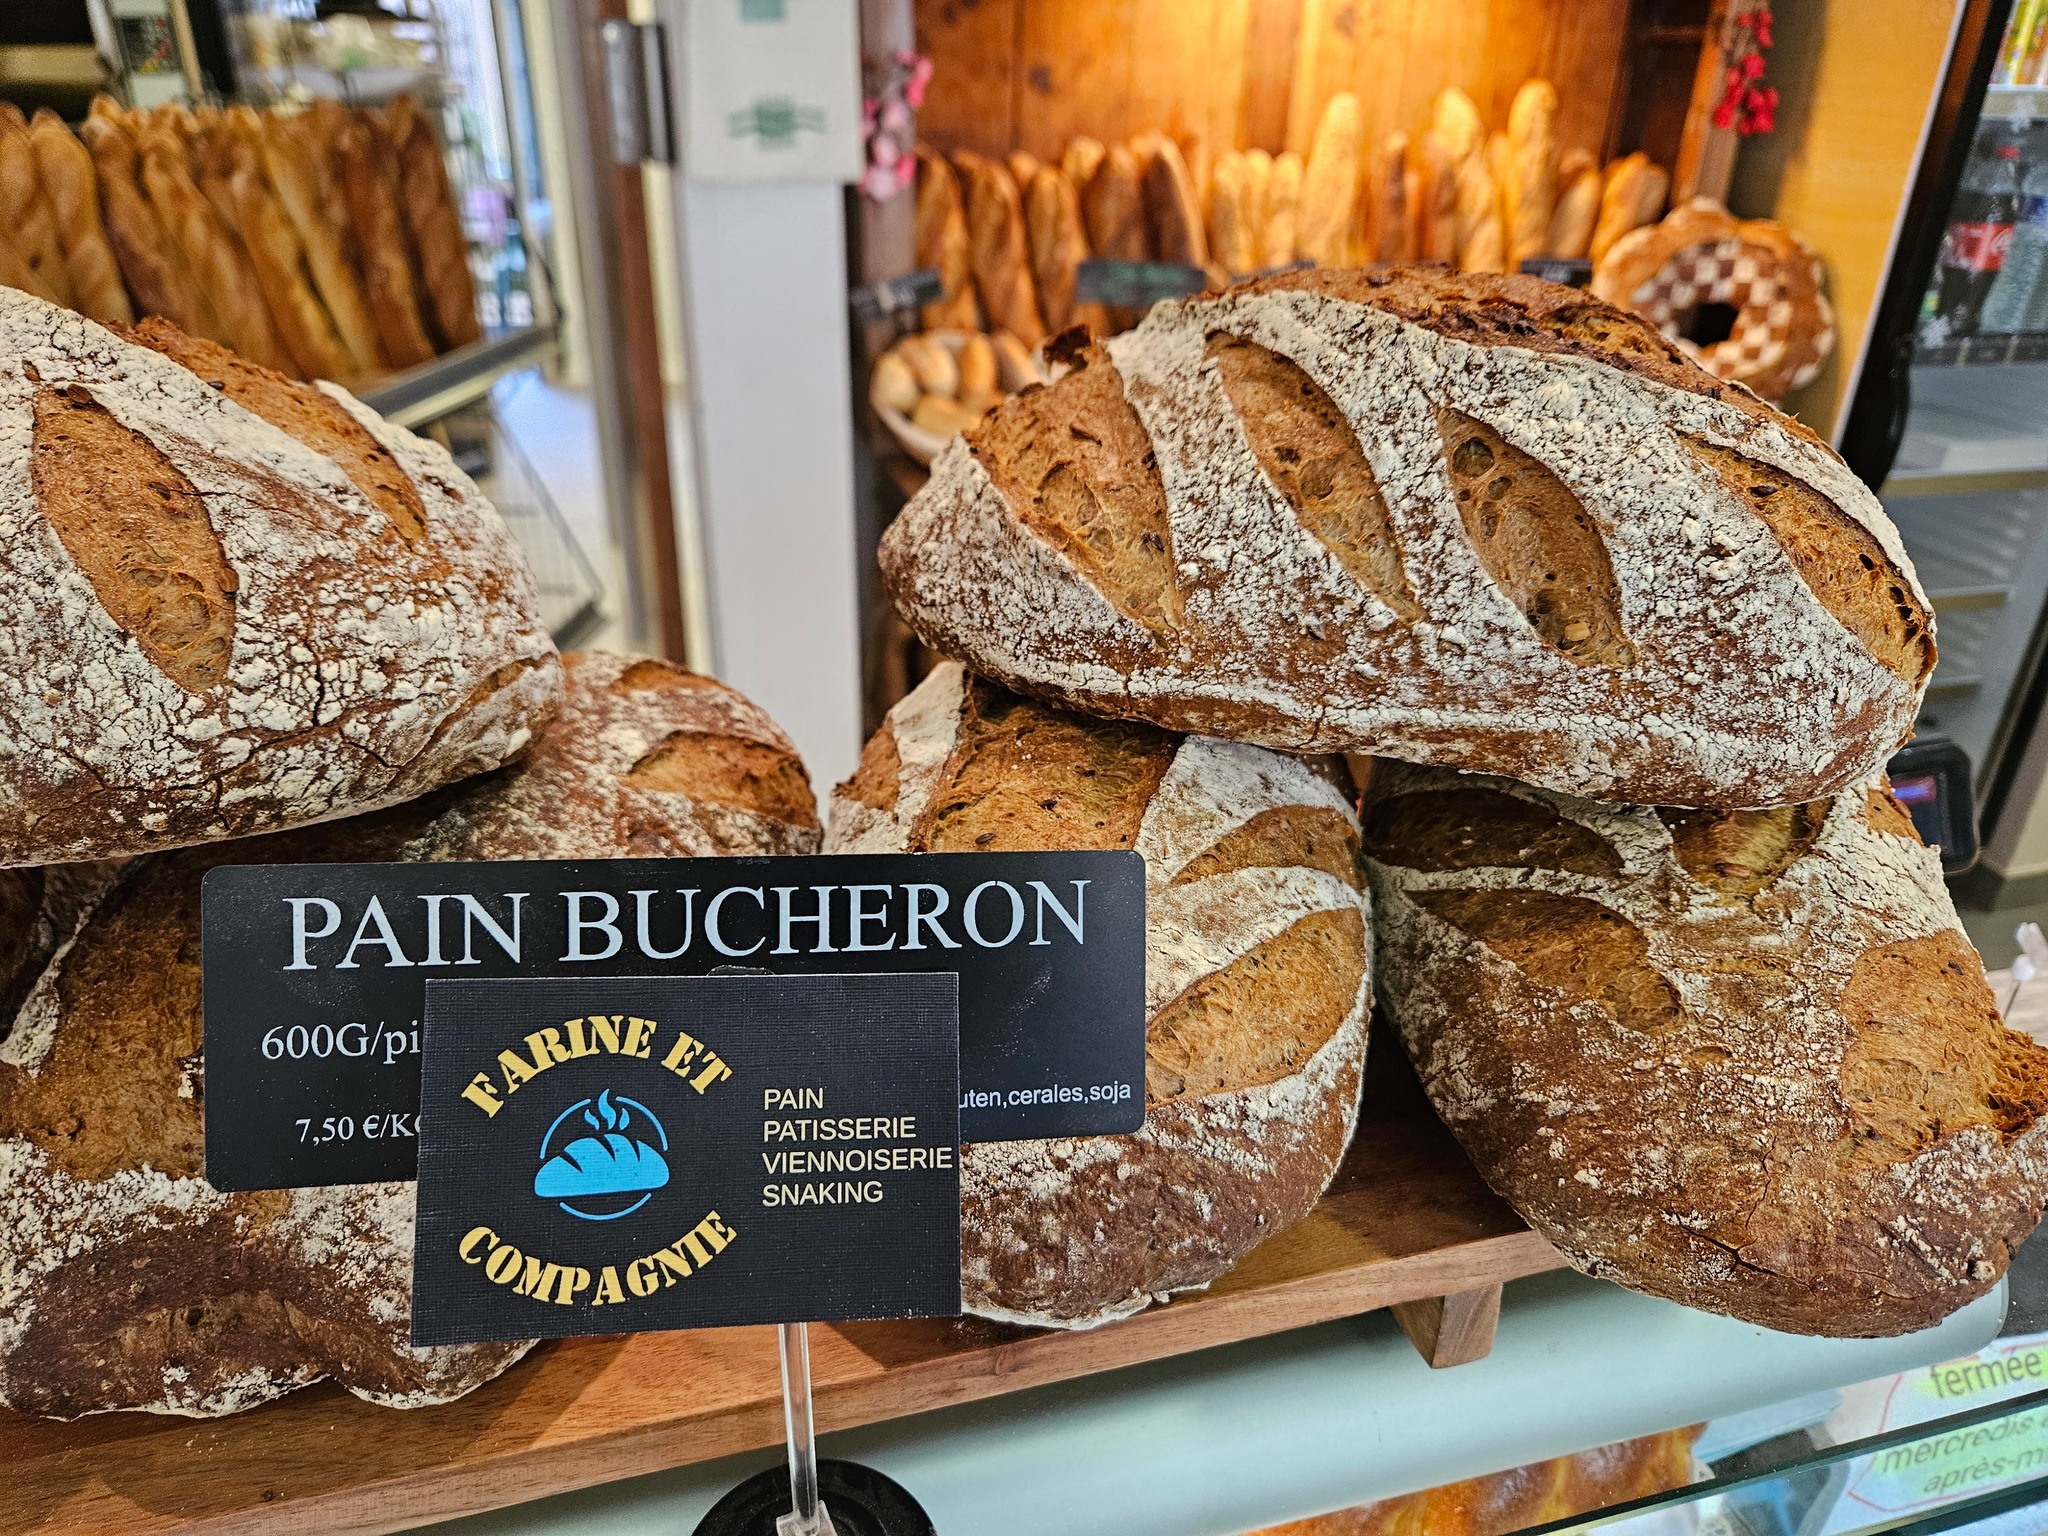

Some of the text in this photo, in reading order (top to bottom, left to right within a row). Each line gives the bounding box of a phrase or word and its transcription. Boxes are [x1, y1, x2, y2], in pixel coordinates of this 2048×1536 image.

[282, 880, 1091, 971] PAIN BUCHERON
[262, 1020, 421, 1065] 600G/pi
[461, 1015, 733, 1118] FARINE ET
[764, 1087, 824, 1110] PAIN
[295, 1116, 355, 1146] 7,50
[763, 1116, 917, 1142] PATISSERIE
[762, 1147, 953, 1174] VIENNOISERIE
[762, 1180, 884, 1207] SNAKING
[459, 1210, 737, 1306] COMPAGNIE
[1923, 1446, 2048, 1494] après-m
